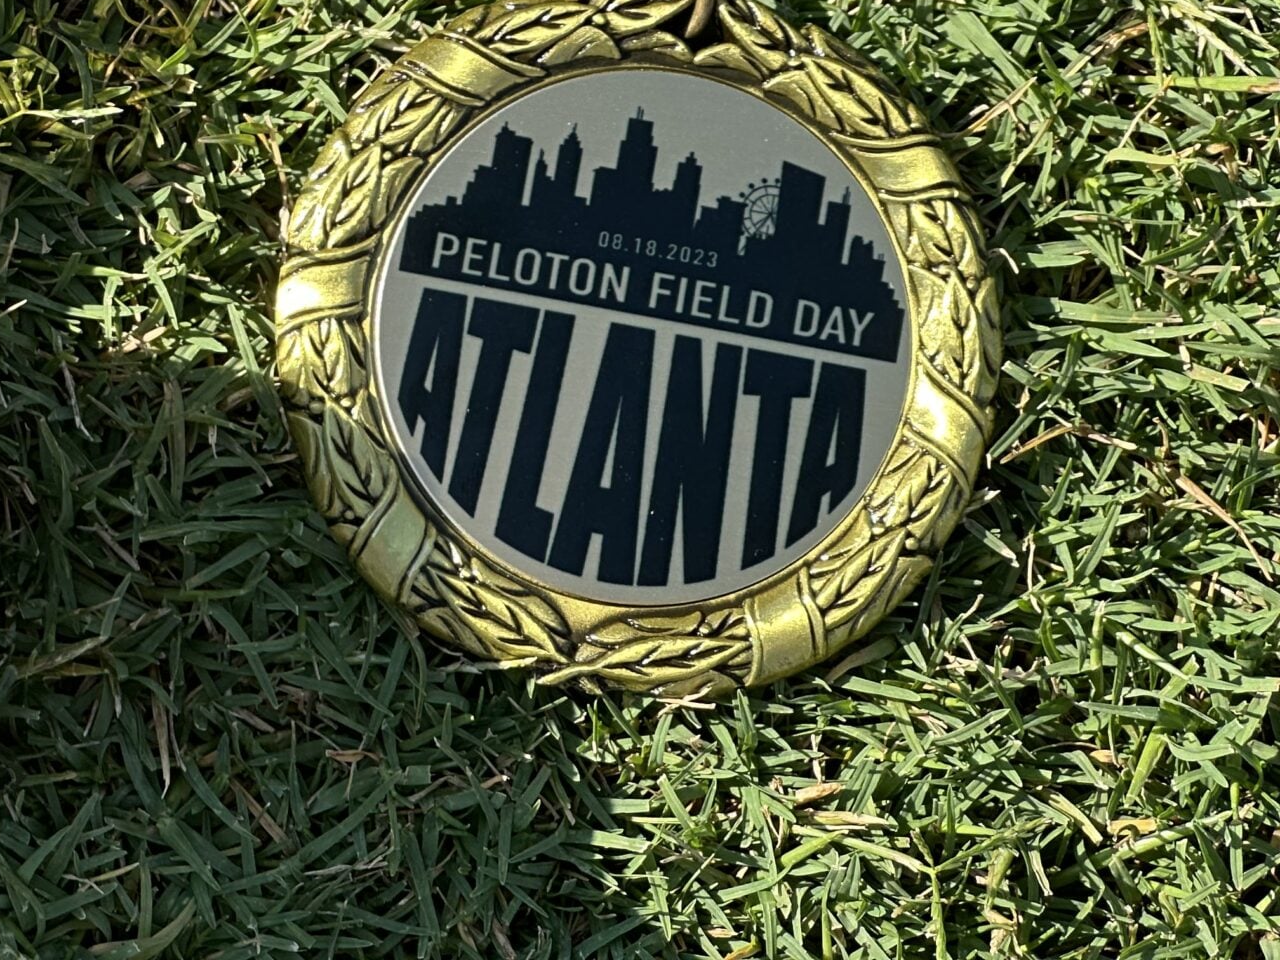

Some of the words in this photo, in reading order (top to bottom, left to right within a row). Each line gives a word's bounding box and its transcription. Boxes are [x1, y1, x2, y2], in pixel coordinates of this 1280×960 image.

[431, 231, 631, 303] PELOTON
[648, 272, 774, 328] FIELD
[793, 301, 875, 348] DAY
[598, 230, 719, 269] 08.18.2023
[397, 286, 867, 587] ATLANTA
